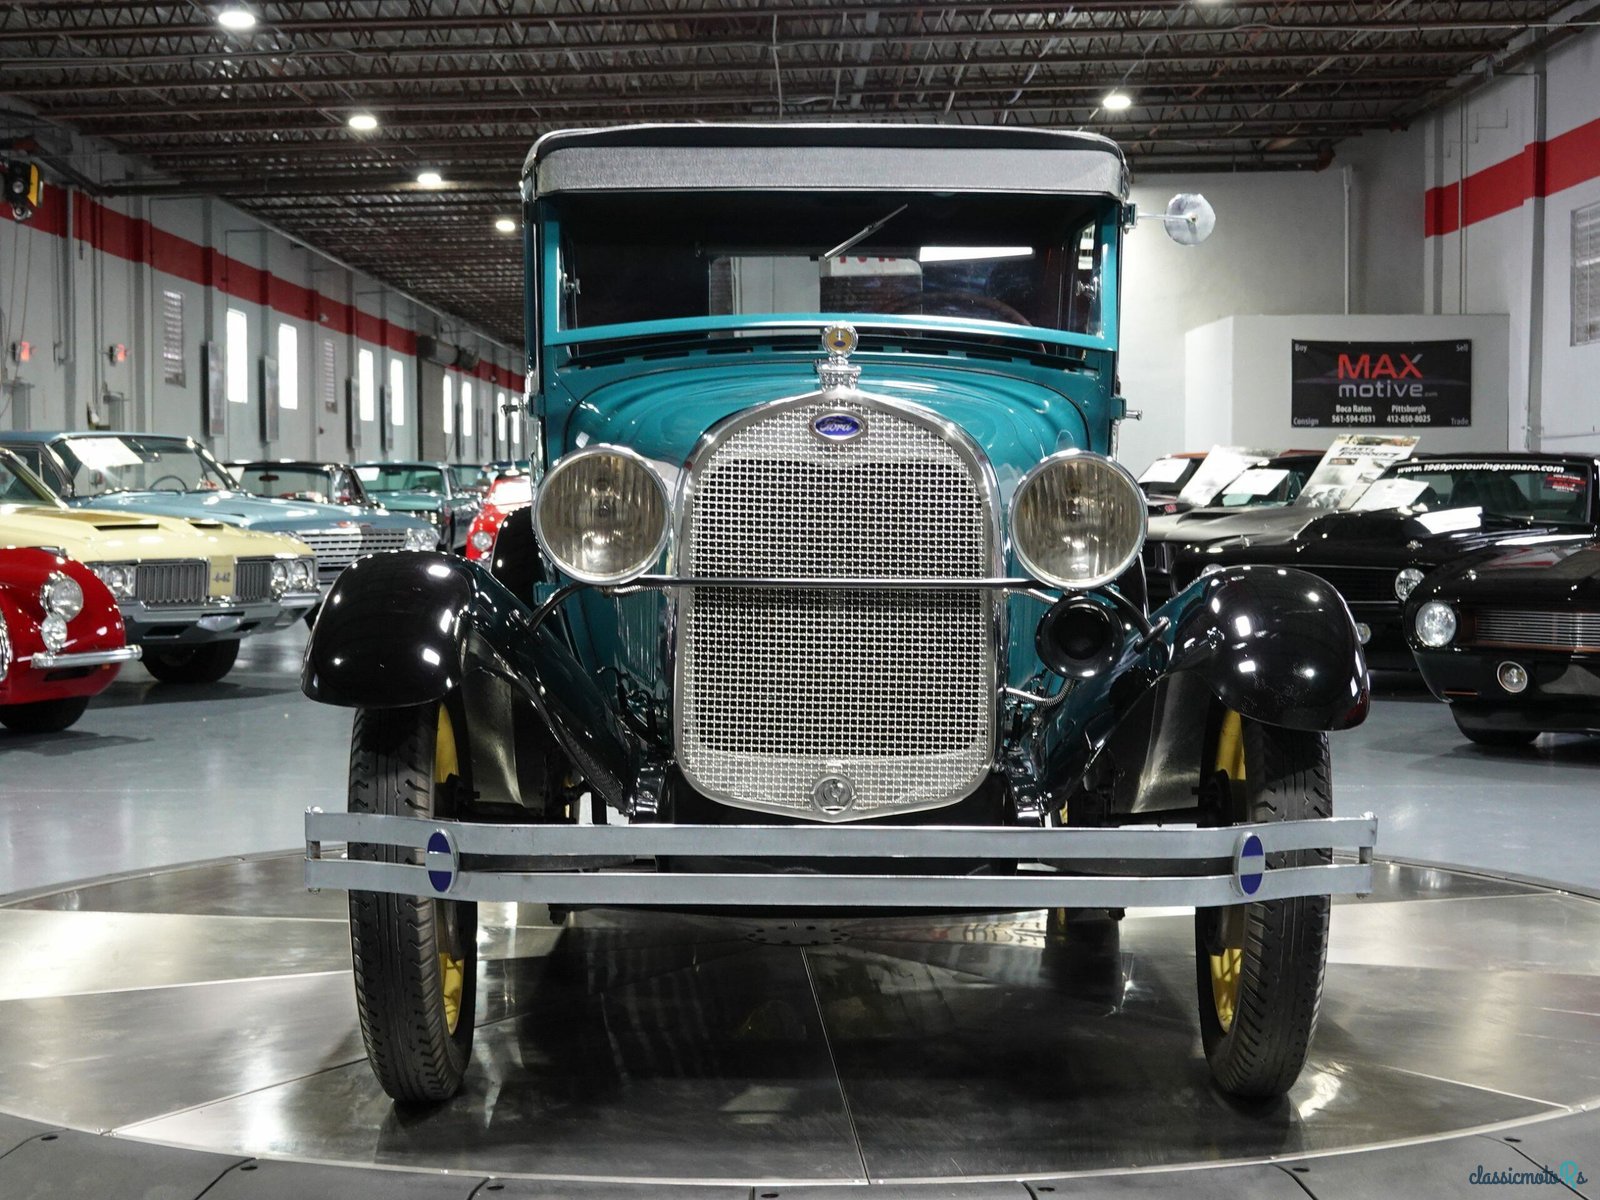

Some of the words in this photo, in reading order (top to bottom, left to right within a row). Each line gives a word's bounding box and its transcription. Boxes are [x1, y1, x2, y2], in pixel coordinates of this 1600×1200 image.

[1294, 344, 1308, 352] Buy
[1456, 344, 1469, 352] Sell
[1337, 353, 1423, 379] MAX
[1338, 380, 1424, 398] motive
[1335, 404, 1352, 413] Boca
[1353, 404, 1373, 413] Raton
[1391, 404, 1426, 414] Pittsburgh
[820, 418, 853, 432] Ford
[1293, 417, 1319, 426] Consign
[1450, 417, 1469, 426] Trade
